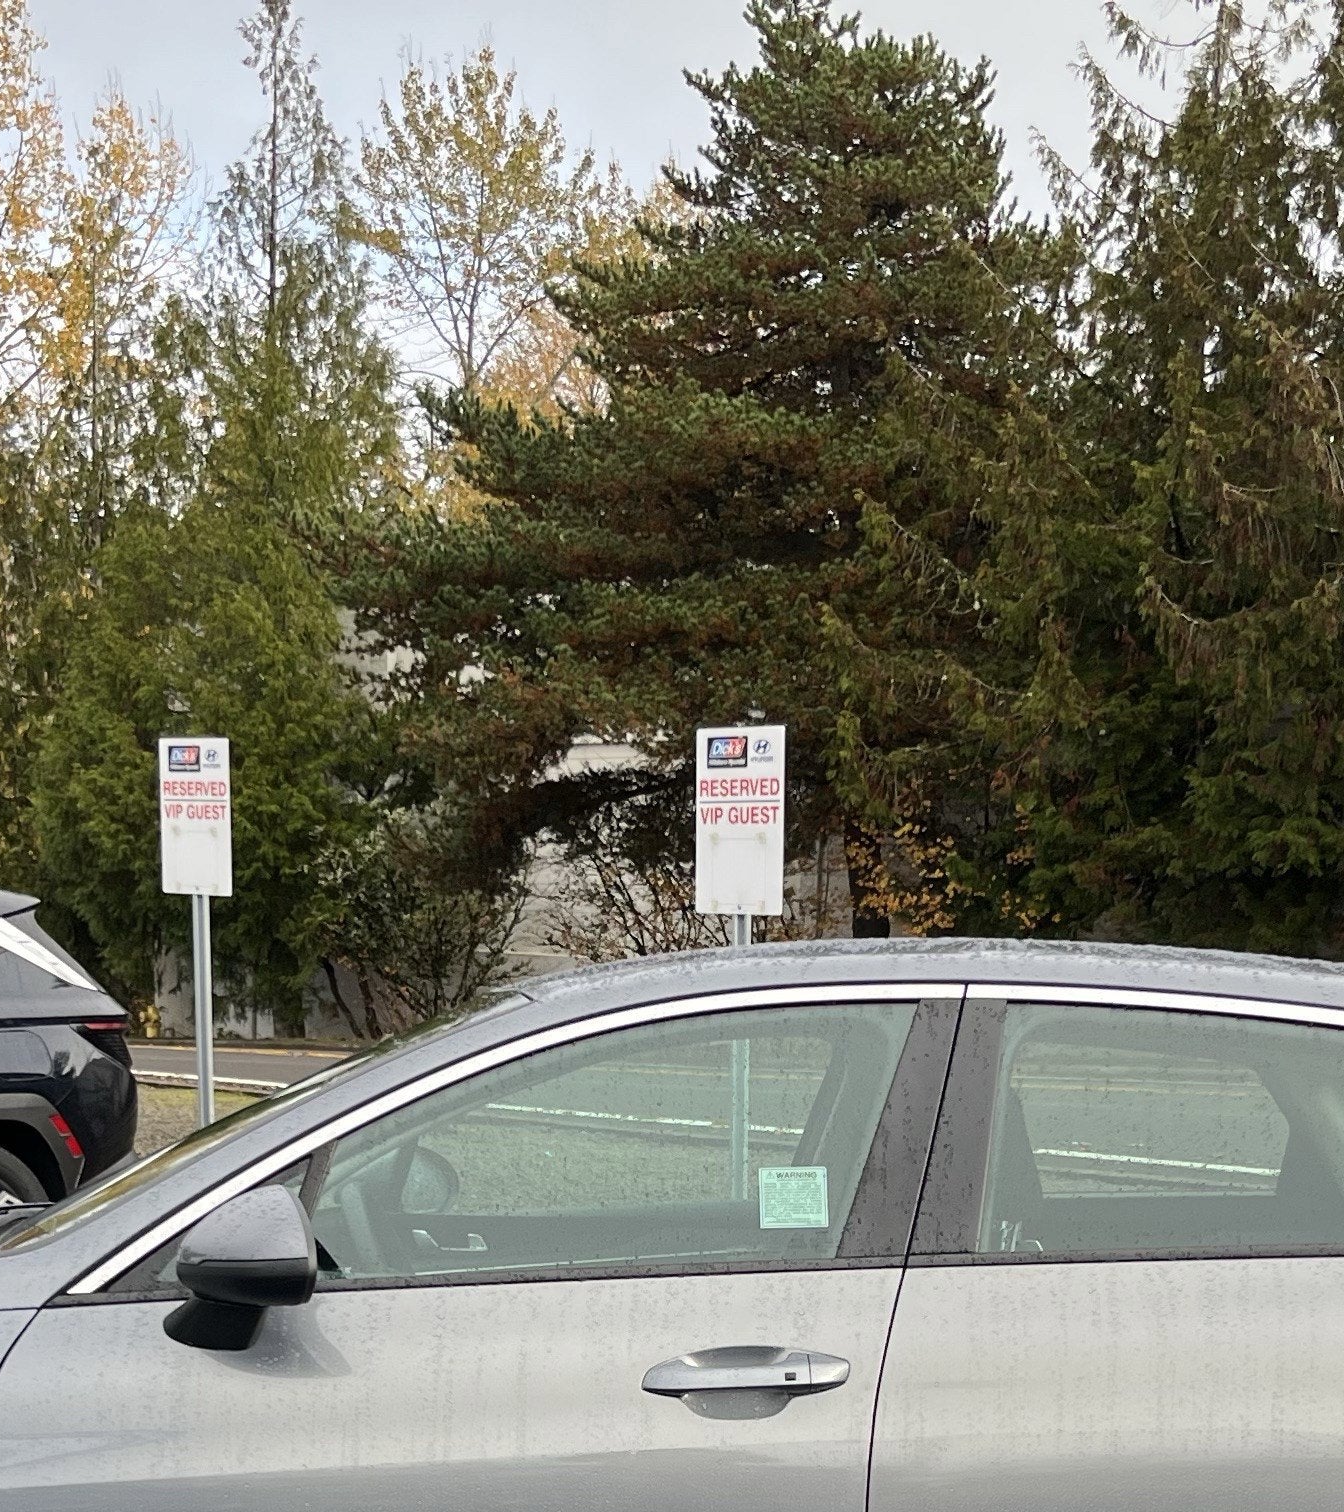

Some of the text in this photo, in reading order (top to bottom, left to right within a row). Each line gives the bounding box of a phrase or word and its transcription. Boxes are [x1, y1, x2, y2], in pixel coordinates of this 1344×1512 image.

[163, 781, 227, 796] RESERVED
[699, 778, 780, 797] RESERVED
[165, 804, 227, 819] VIP GUEST
[701, 806, 779, 825] VIP GUEST
[776, 1171, 818, 1179] WARNING
